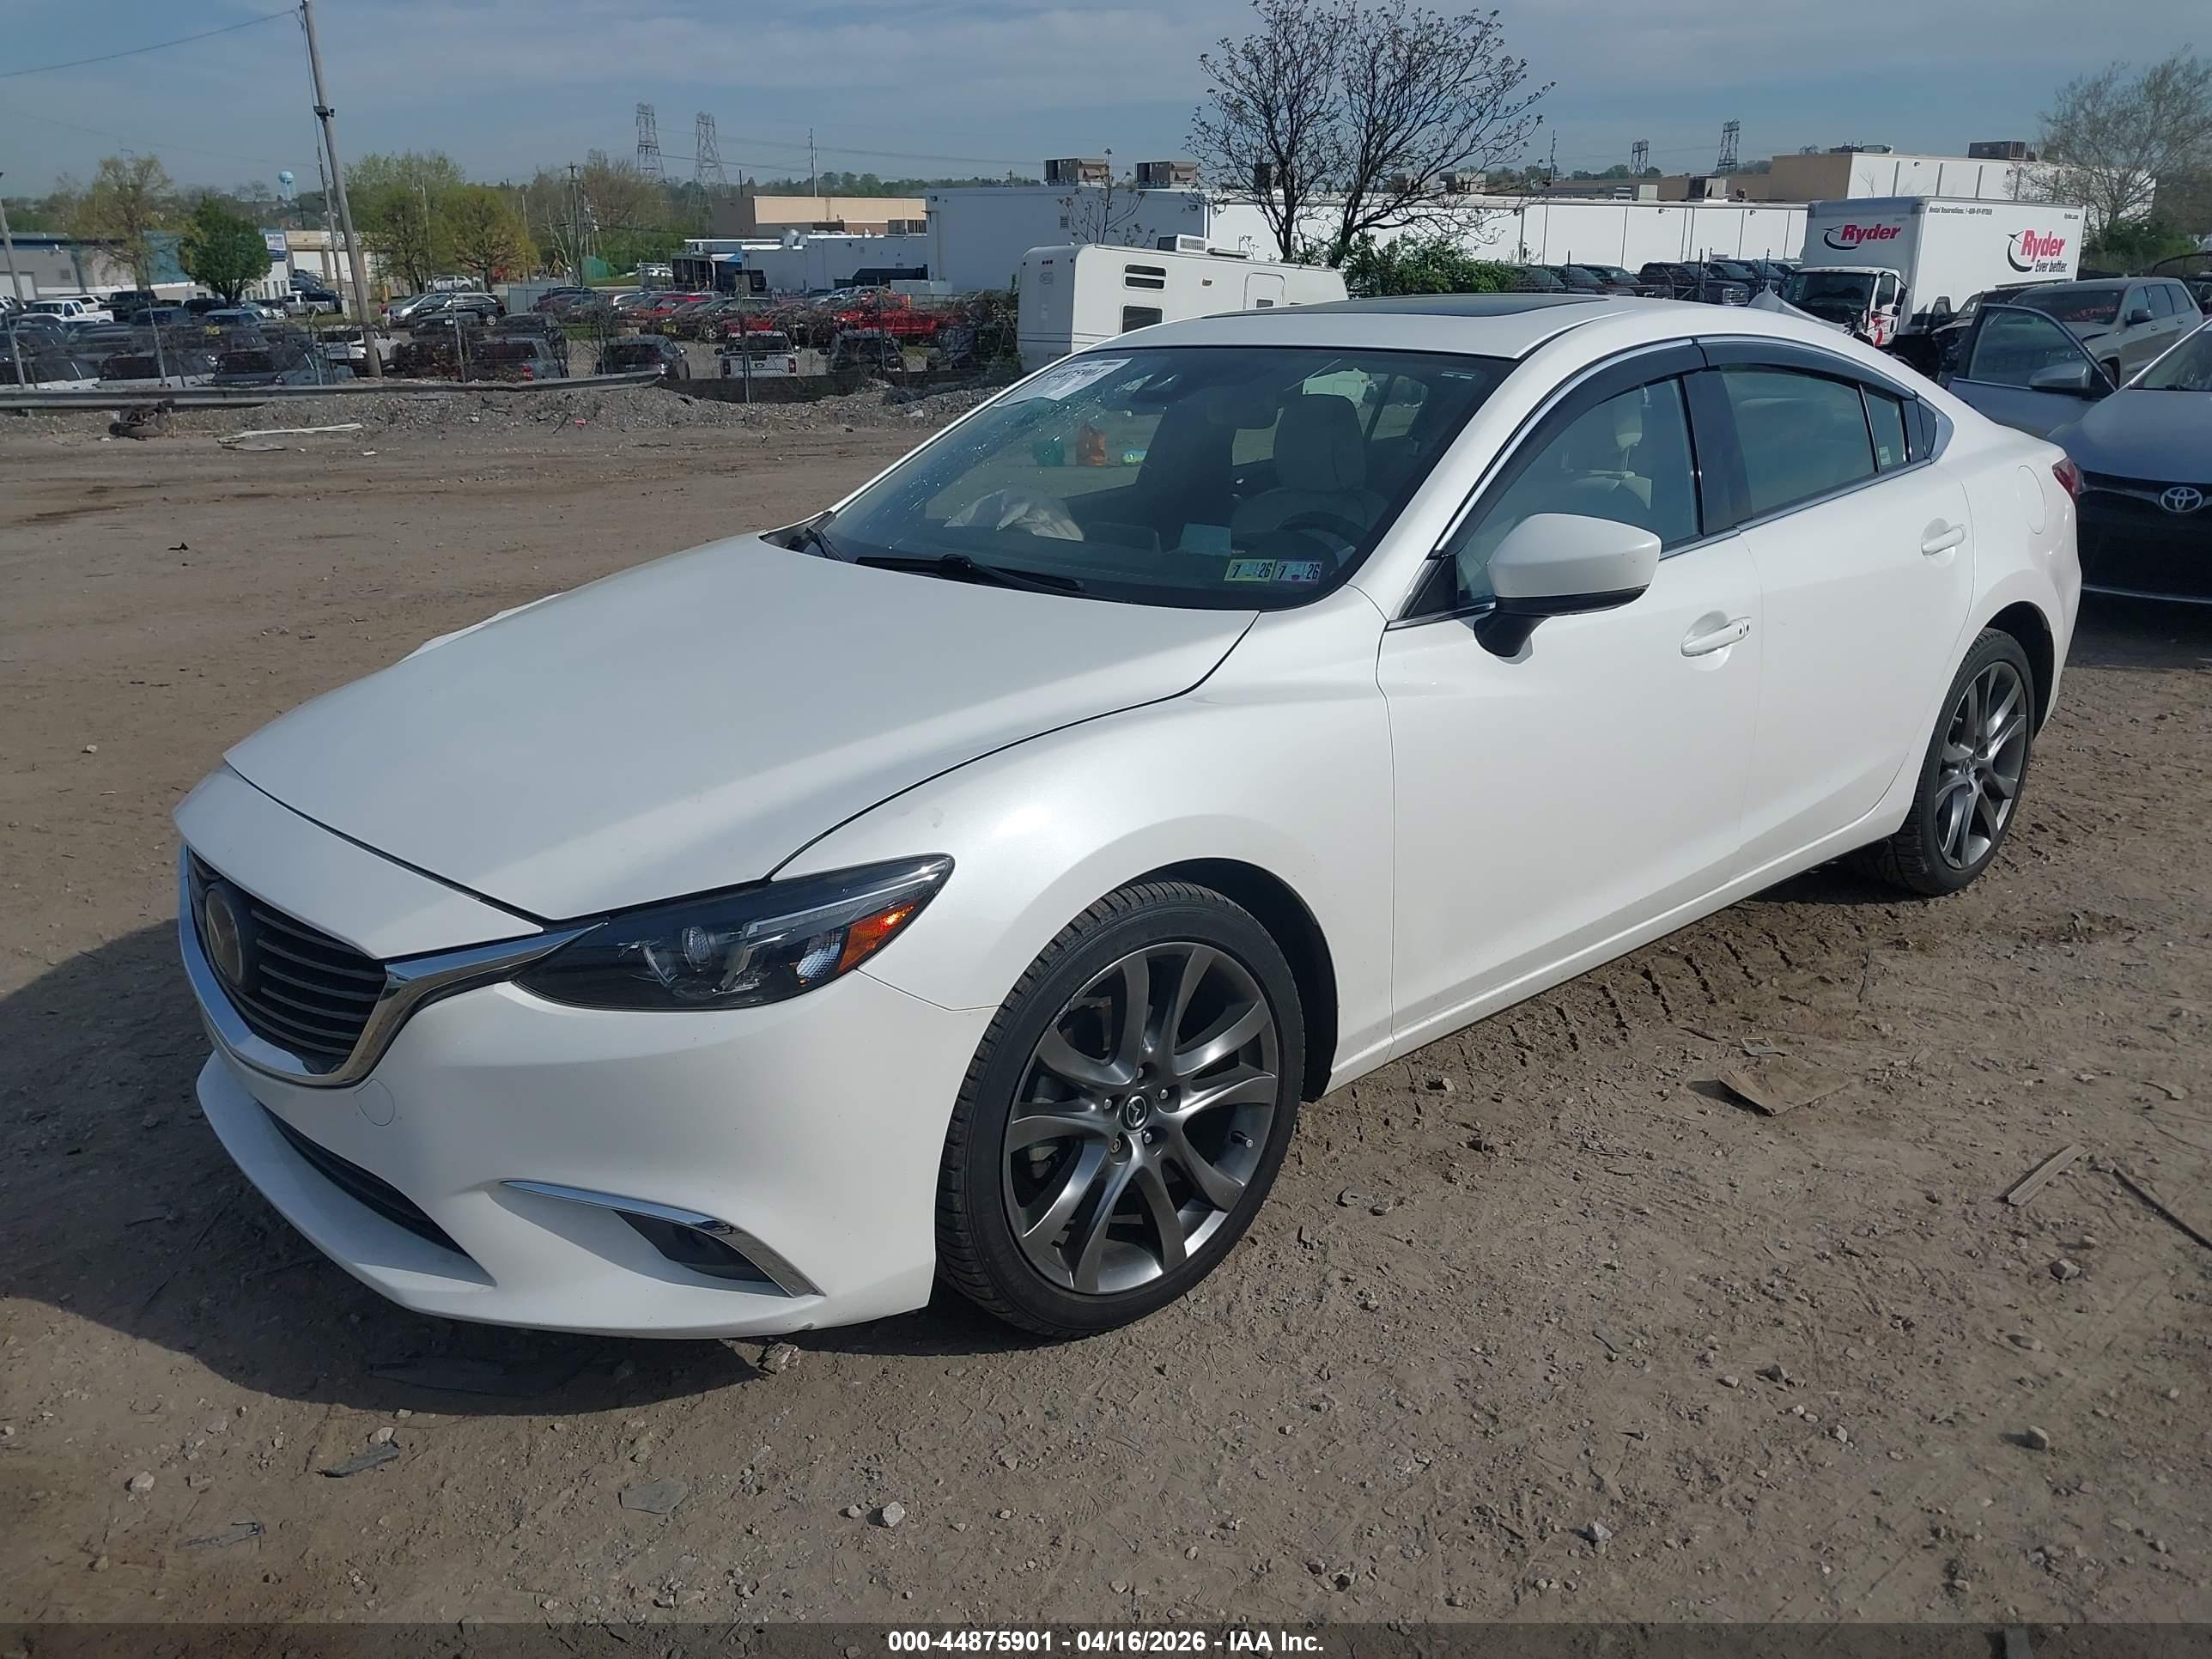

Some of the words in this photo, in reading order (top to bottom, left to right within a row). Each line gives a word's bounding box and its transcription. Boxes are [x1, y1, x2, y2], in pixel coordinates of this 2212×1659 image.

[1840, 223, 1901, 244] Ryder
[2021, 229, 2066, 262] Ryder
[2035, 259, 2049, 272] Ever
[1232, 565, 1241, 578] 7
[1258, 562, 1273, 578] 26
[1278, 566, 1286, 579] 7
[1307, 563, 1320, 580] 26
